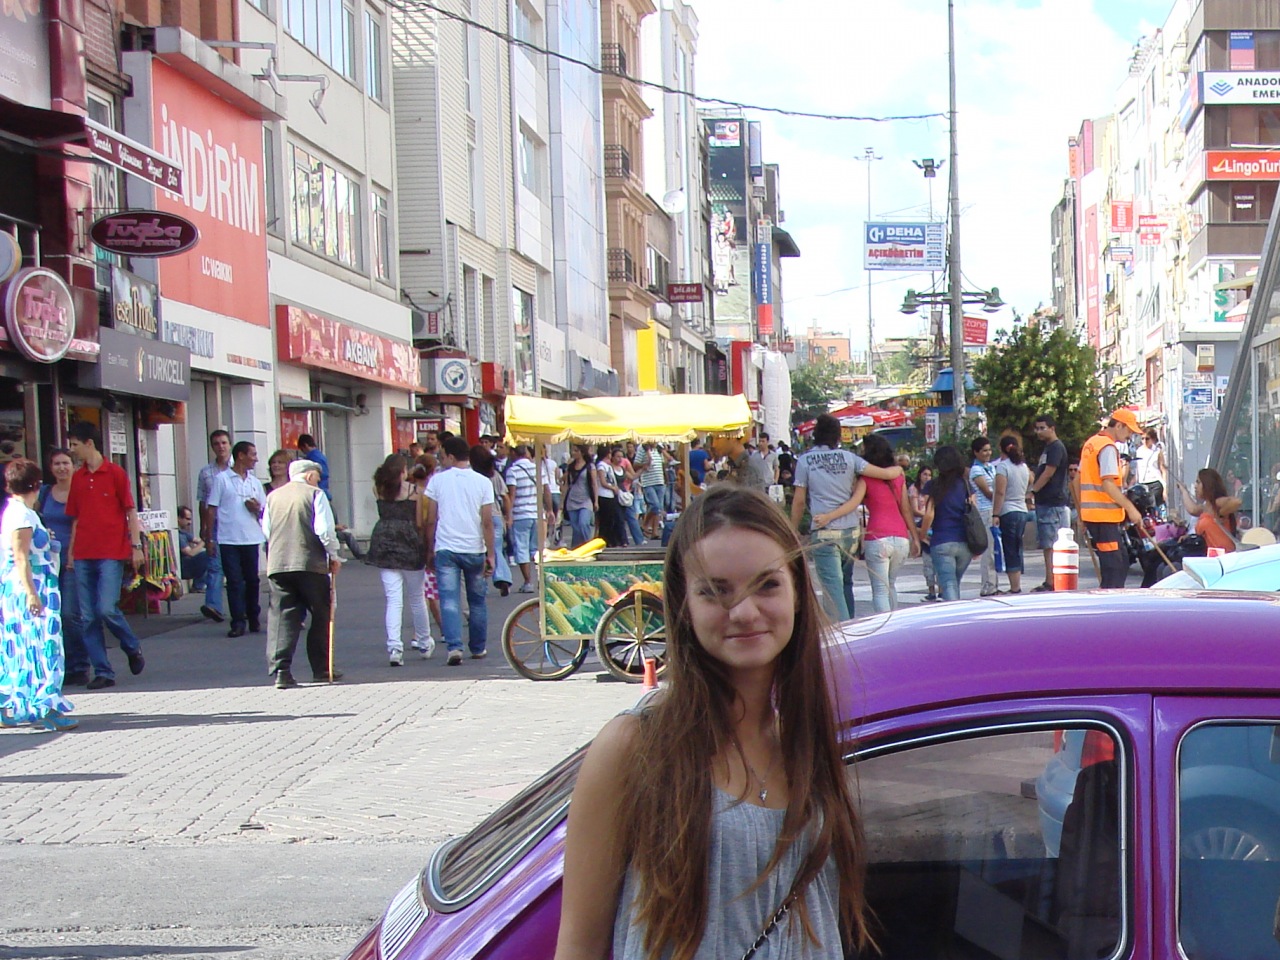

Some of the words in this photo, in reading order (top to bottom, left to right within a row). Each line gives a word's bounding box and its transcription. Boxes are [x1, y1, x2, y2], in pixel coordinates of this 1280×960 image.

[161, 103, 260, 236] İNDİRİM
[886, 227, 923, 237] DEHA
[344, 340, 378, 368] AKBANK
[148, 355, 185, 386] TURKCELL
[419, 423, 439, 431] LENS
